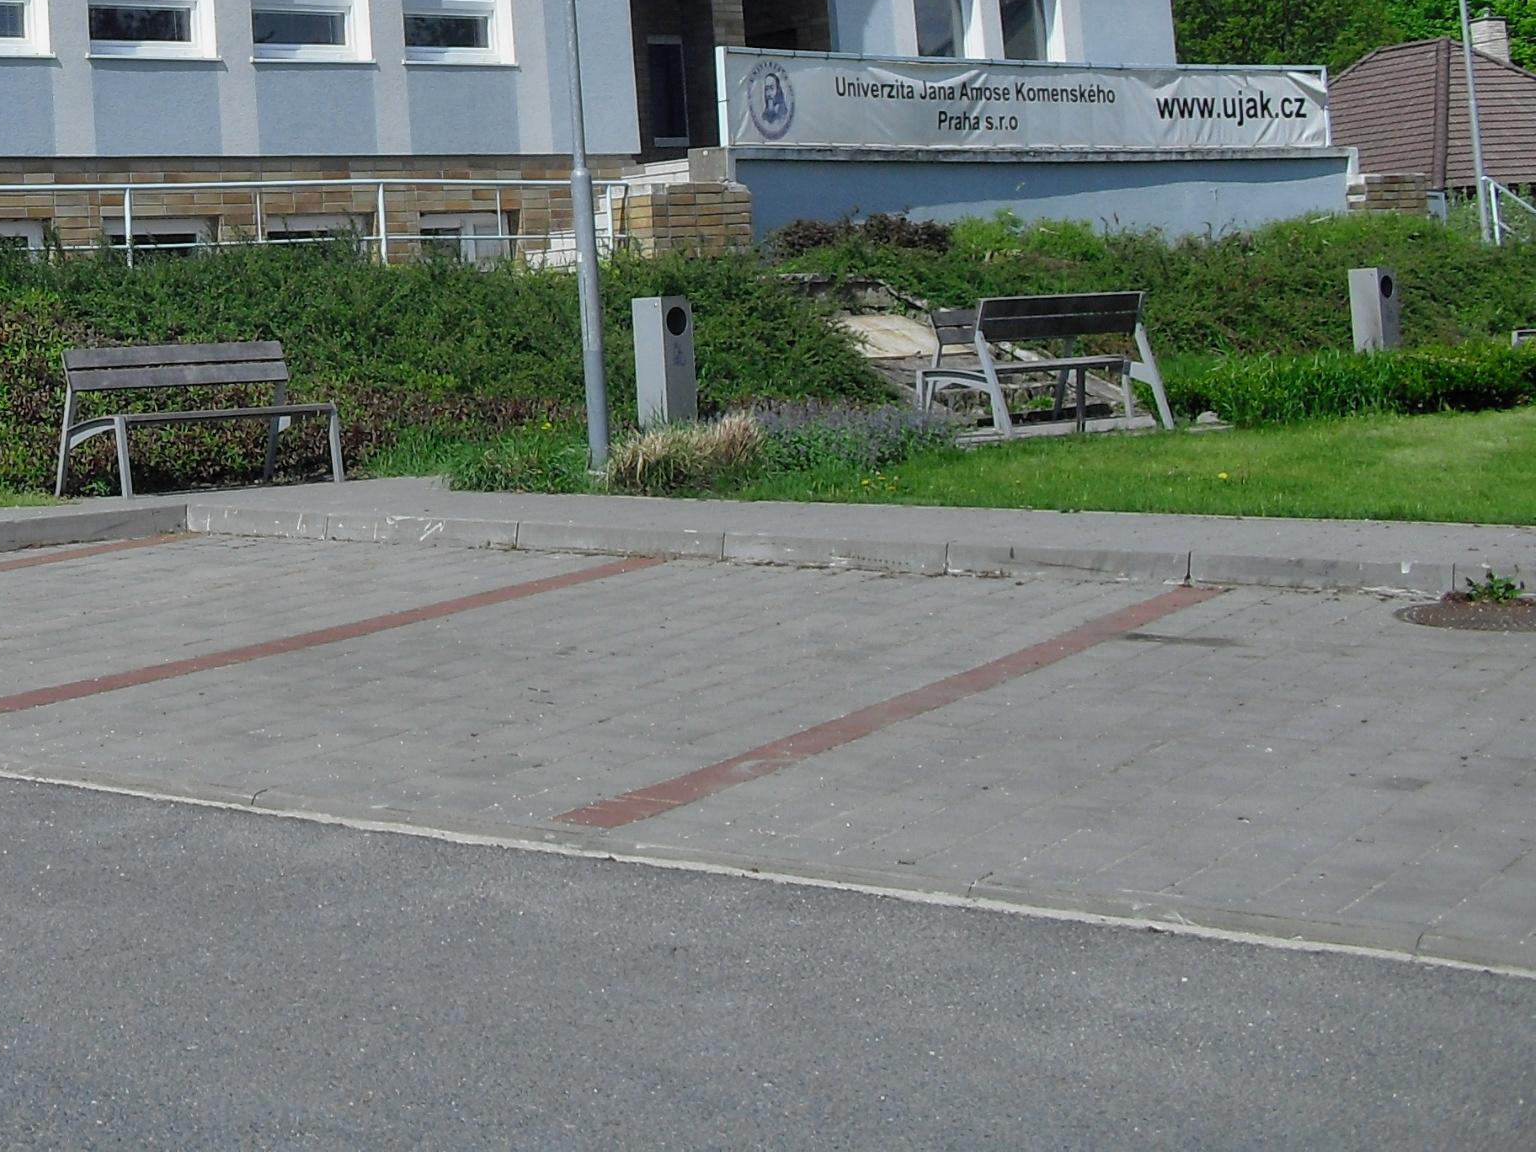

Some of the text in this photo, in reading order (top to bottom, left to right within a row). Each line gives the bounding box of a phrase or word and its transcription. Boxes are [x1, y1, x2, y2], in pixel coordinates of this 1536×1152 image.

[835, 76, 1116, 104] Univerzita Jana Amose Komenského
[938, 111, 1019, 131] Praha s.r.o
[1156, 90, 1307, 127] www.ujak.cz
